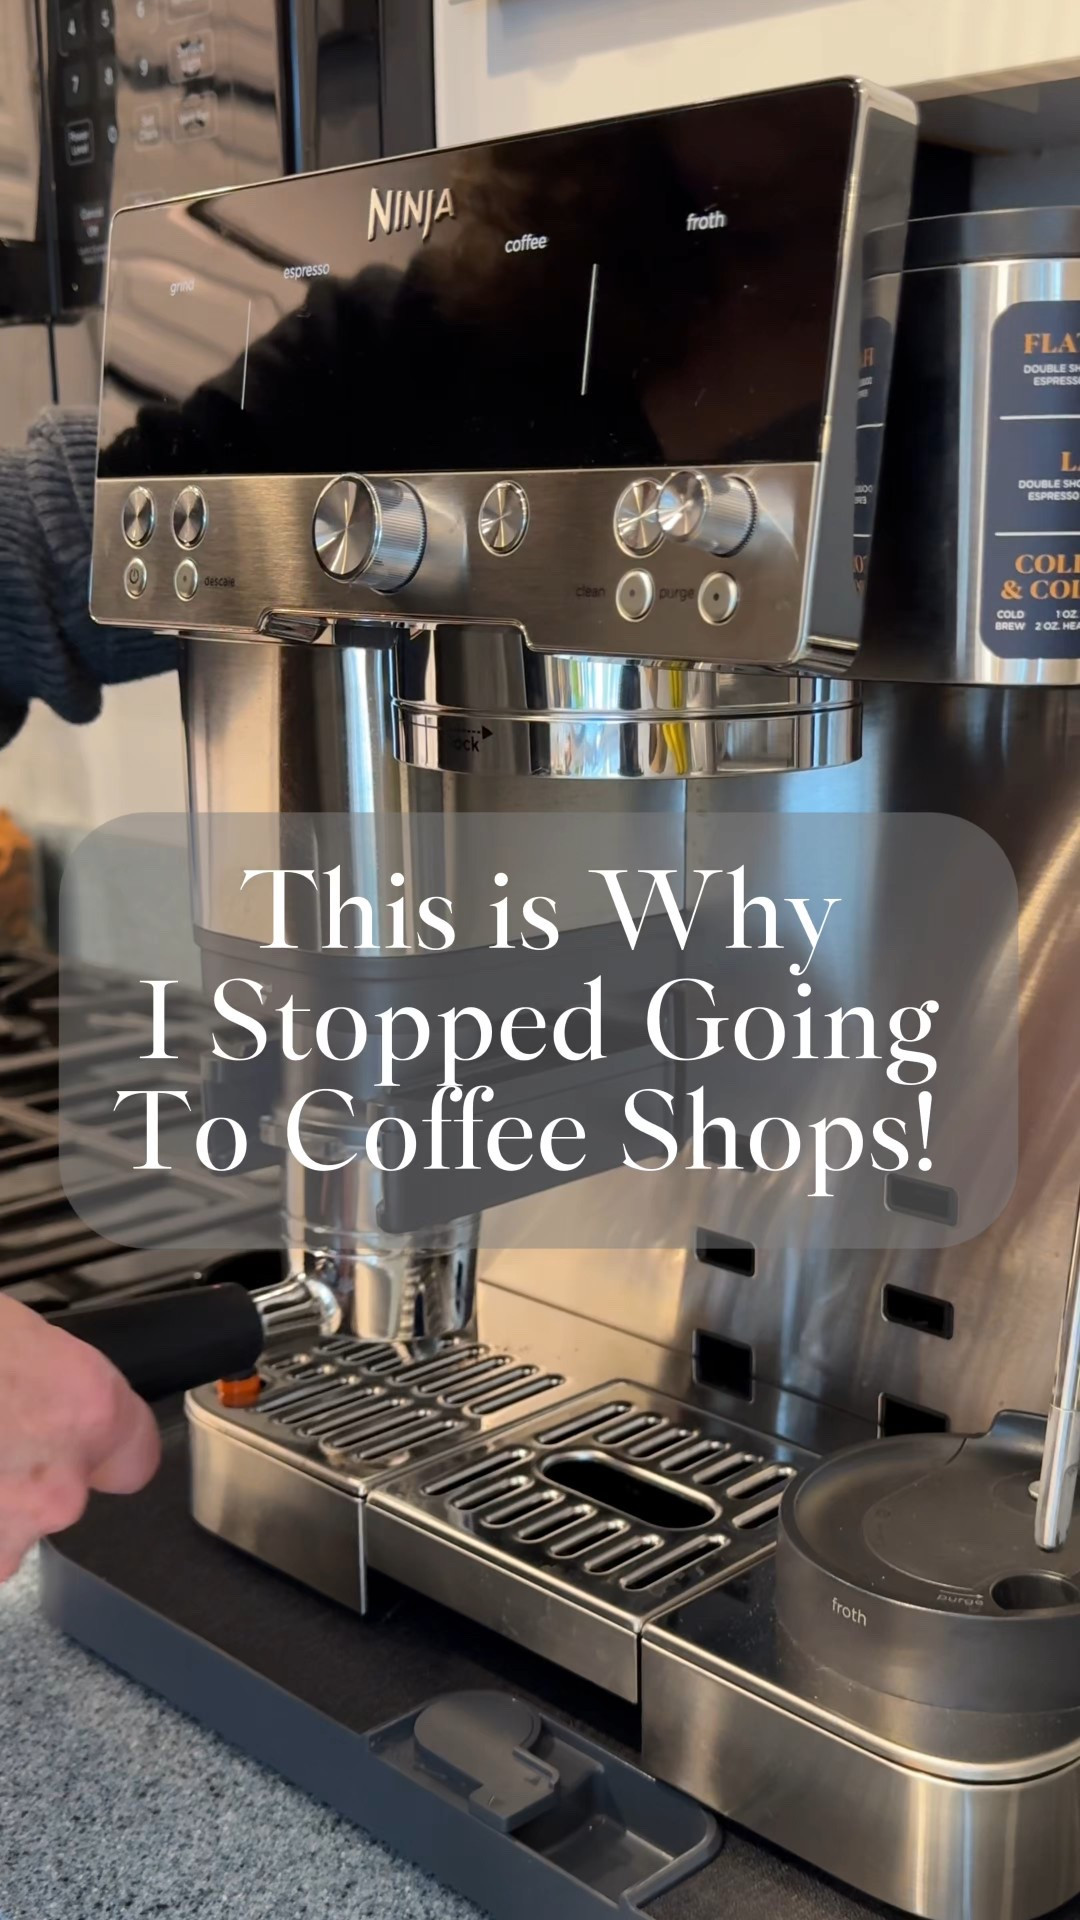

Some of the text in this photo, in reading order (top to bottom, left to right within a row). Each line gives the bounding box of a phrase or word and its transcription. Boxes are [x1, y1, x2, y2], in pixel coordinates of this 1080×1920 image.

[367, 187, 456, 241] NINJA
[686, 210, 727, 231] froth
[504, 234, 549, 253] coffee
[283, 262, 331, 280] espresso
[169, 278, 195, 296] grind
[1023, 364, 1067, 374] DOUBLE
[1018, 480, 1061, 489] DOUBLE
[1028, 491, 1080, 501] ESPRESSO
[204, 576, 236, 588] descale
[1001, 579, 1023, 600] &
[575, 585, 606, 599] clean
[658, 587, 695, 602] purge
[996, 610, 1025, 619] COLD
[995, 622, 1026, 631] BREW
[1035, 622, 1041, 631] 2
[451, 736, 480, 752] ock
[832, 1597, 867, 1627] froth
